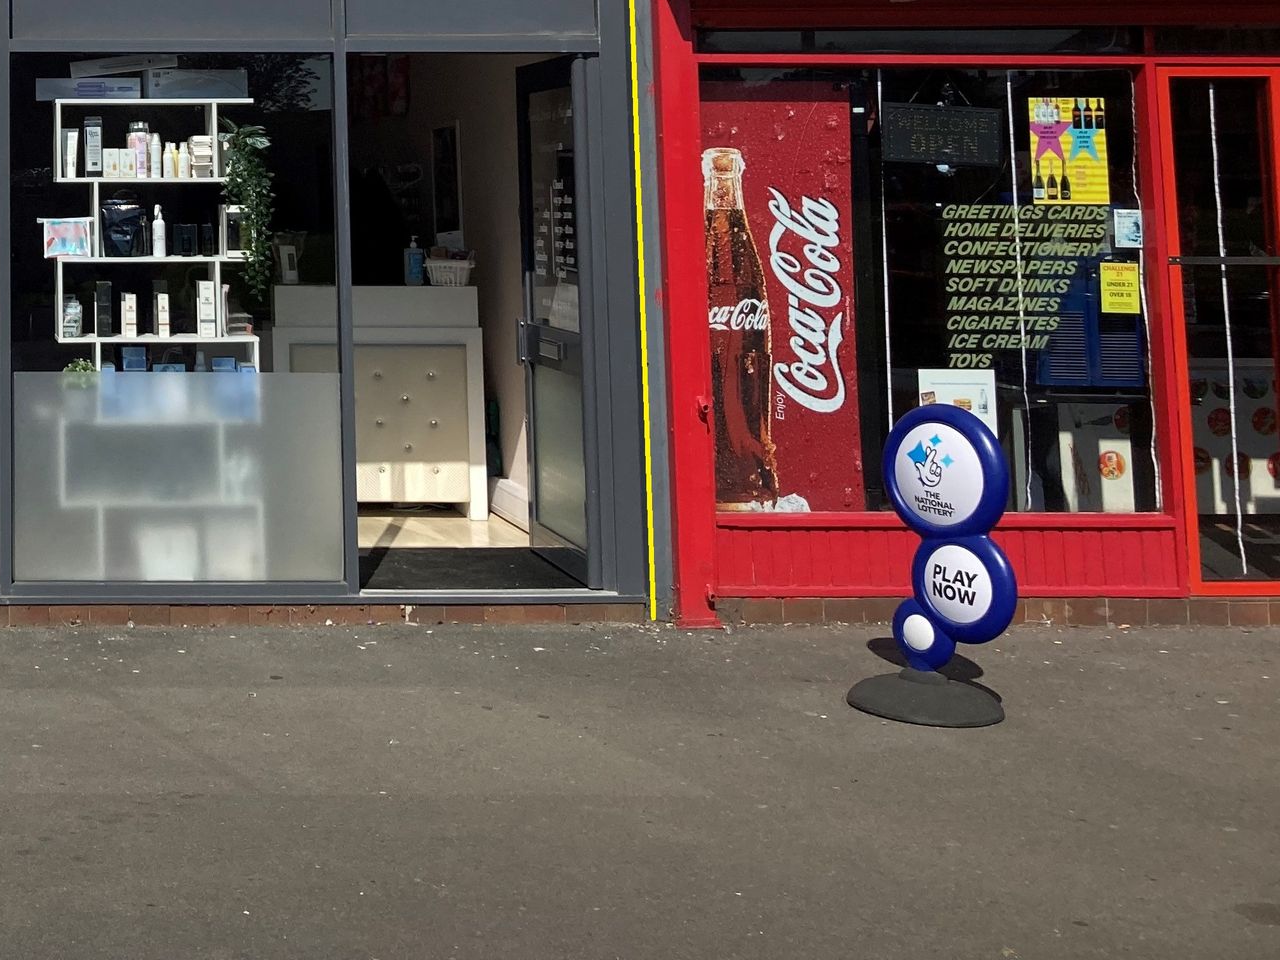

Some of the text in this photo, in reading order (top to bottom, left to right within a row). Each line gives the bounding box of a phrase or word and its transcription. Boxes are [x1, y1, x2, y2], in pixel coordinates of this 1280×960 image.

[942, 204, 1045, 220] GREETINGS
[1047, 205, 1109, 221] CARDS
[944, 222, 1107, 238] HOME DELIVERIES
[944, 240, 1104, 257] CONFECTIONERY
[945, 259, 1078, 275] NEWSPAPERS
[945, 277, 1071, 294] SOFT DRINKS
[768, 186, 846, 413] Coca-Cola
[946, 296, 1061, 312] MAGAZINES
[946, 315, 1061, 331] CIGARETTES
[948, 334, 1050, 349] ICE CREAM
[949, 353, 993, 368] TOYS
[775, 391, 786, 420] Enjoy
[914, 494, 955, 511] NATIONAL
[924, 490, 940, 500] THE
[917, 505, 953, 518] LOTTERY
[933, 563, 978, 588] PLAY
[932, 581, 976, 606] NOW
